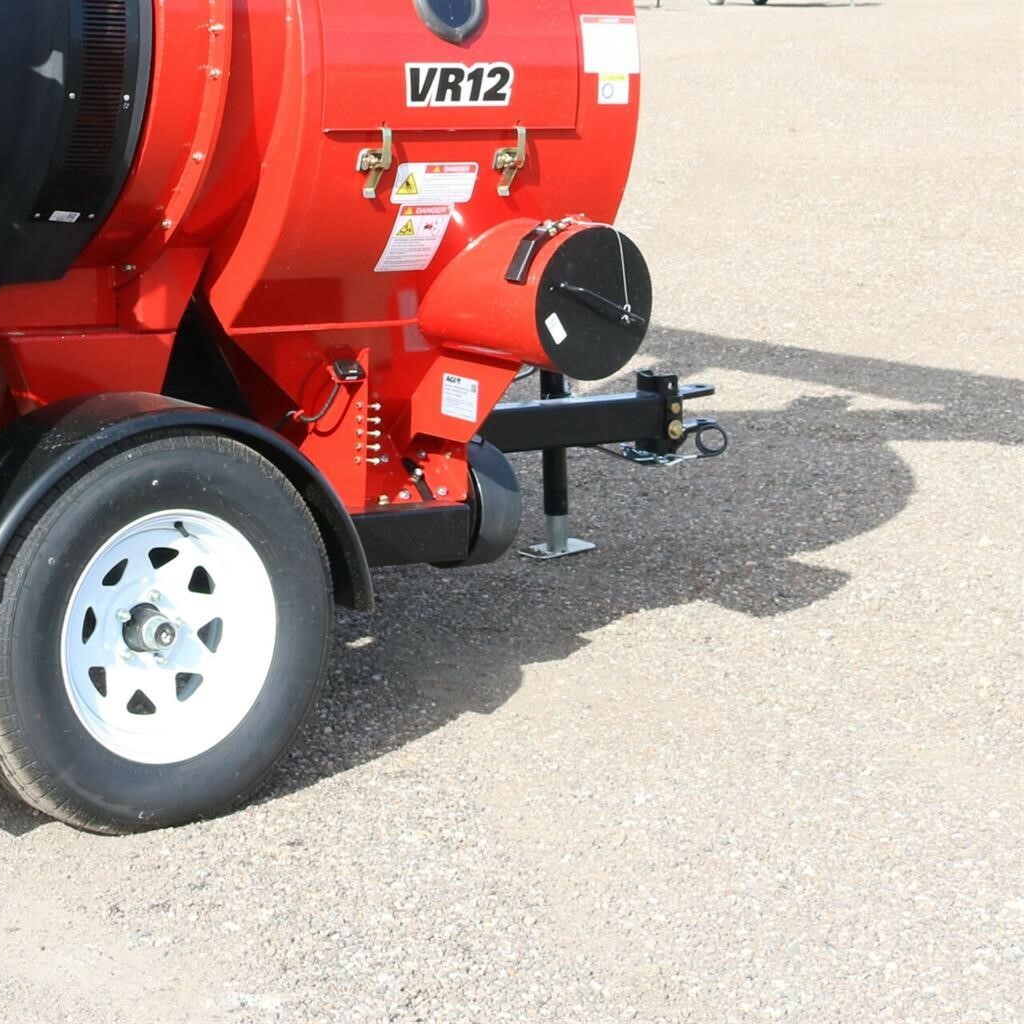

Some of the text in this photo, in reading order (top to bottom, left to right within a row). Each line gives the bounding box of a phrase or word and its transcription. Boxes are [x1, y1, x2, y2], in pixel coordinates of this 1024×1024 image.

[409, 66, 510, 102] VR12
[443, 165, 470, 173] DANGER
[415, 206, 447, 214] DANGER
